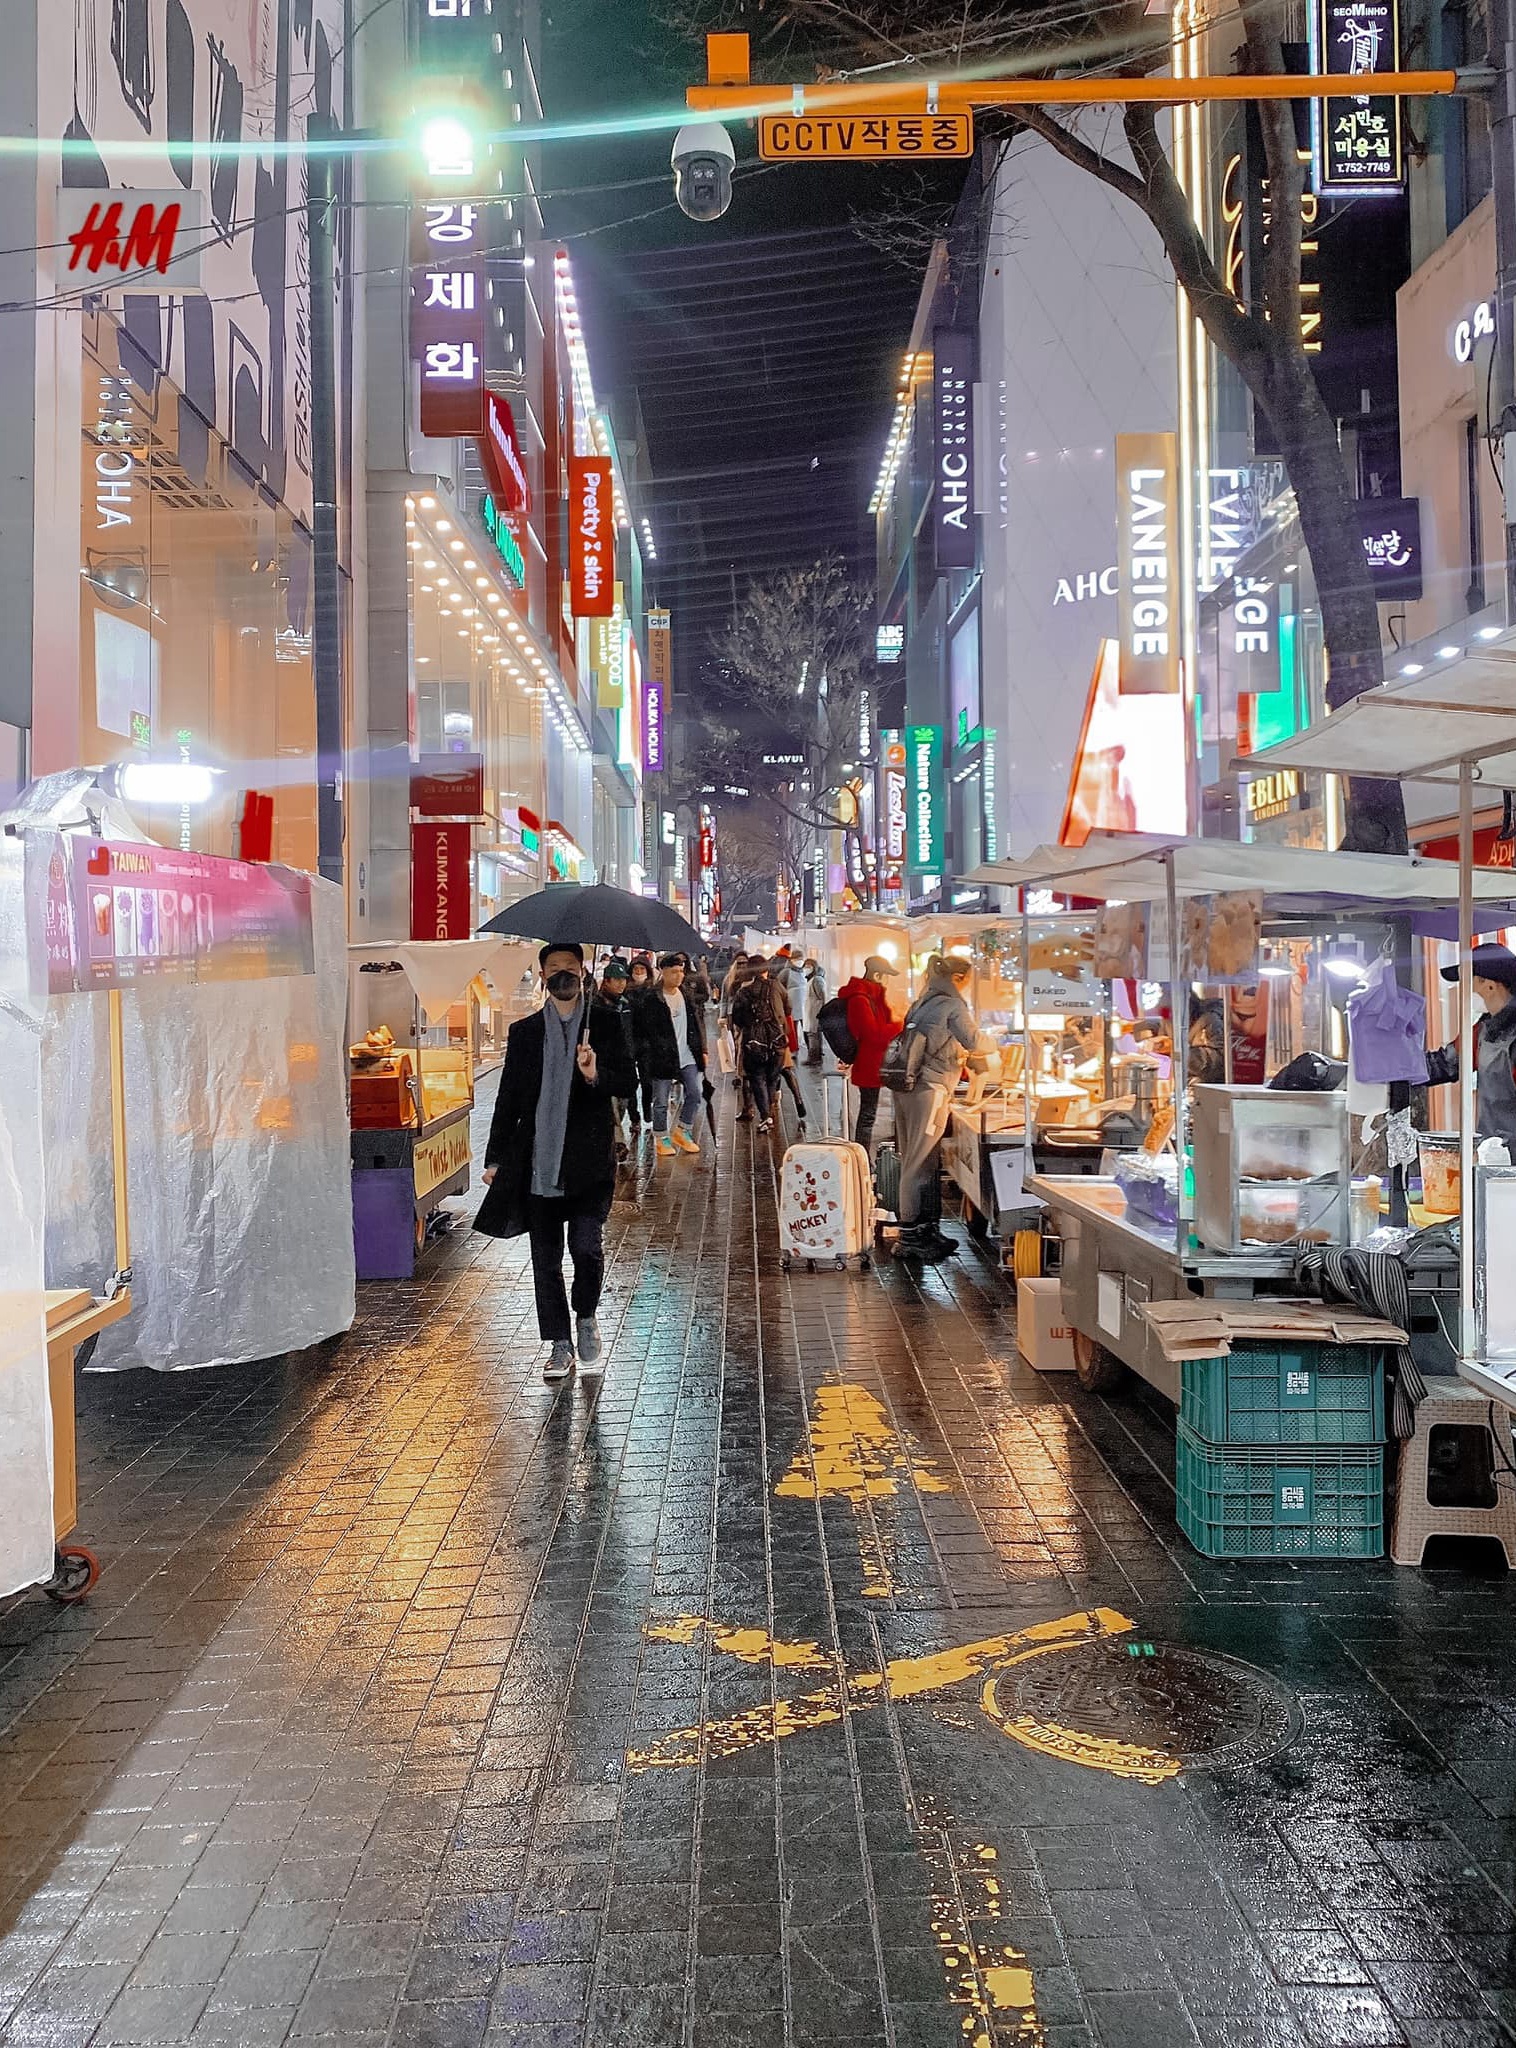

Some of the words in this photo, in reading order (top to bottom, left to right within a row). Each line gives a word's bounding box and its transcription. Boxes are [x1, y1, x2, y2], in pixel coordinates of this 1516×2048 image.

[1333, 3, 1388, 16] SEOMINHO
[772, 119, 958, 151] CCTV작동중
[1334, 108, 1389, 140] 서민호
[1334, 136, 1391, 159] 미용실
[1336, 162, 1390, 174] T.752-7749
[68, 202, 181, 275] H&M
[942, 366, 953, 444] FUTURE
[955, 380, 966, 444] SALON
[580, 472, 600, 537] Pretty
[942, 453, 967, 529] AHC
[584, 555, 602, 599] skin
[1130, 469, 1168, 656] LANEIGE
[1053, 566, 1119, 606] AHC
[877, 625, 903, 638] ABC
[648, 688, 658, 725] HOLIKA
[917, 743, 931, 790] Nature
[1247, 770, 1298, 811] EBLIN
[917, 791, 933, 862] Collection
[110, 851, 152, 874] TAIWAN
[436, 831, 448, 938] KUMKANG
[1033, 987, 1067, 995] BAKED
[789, 1213, 828, 1233] MICKEY
